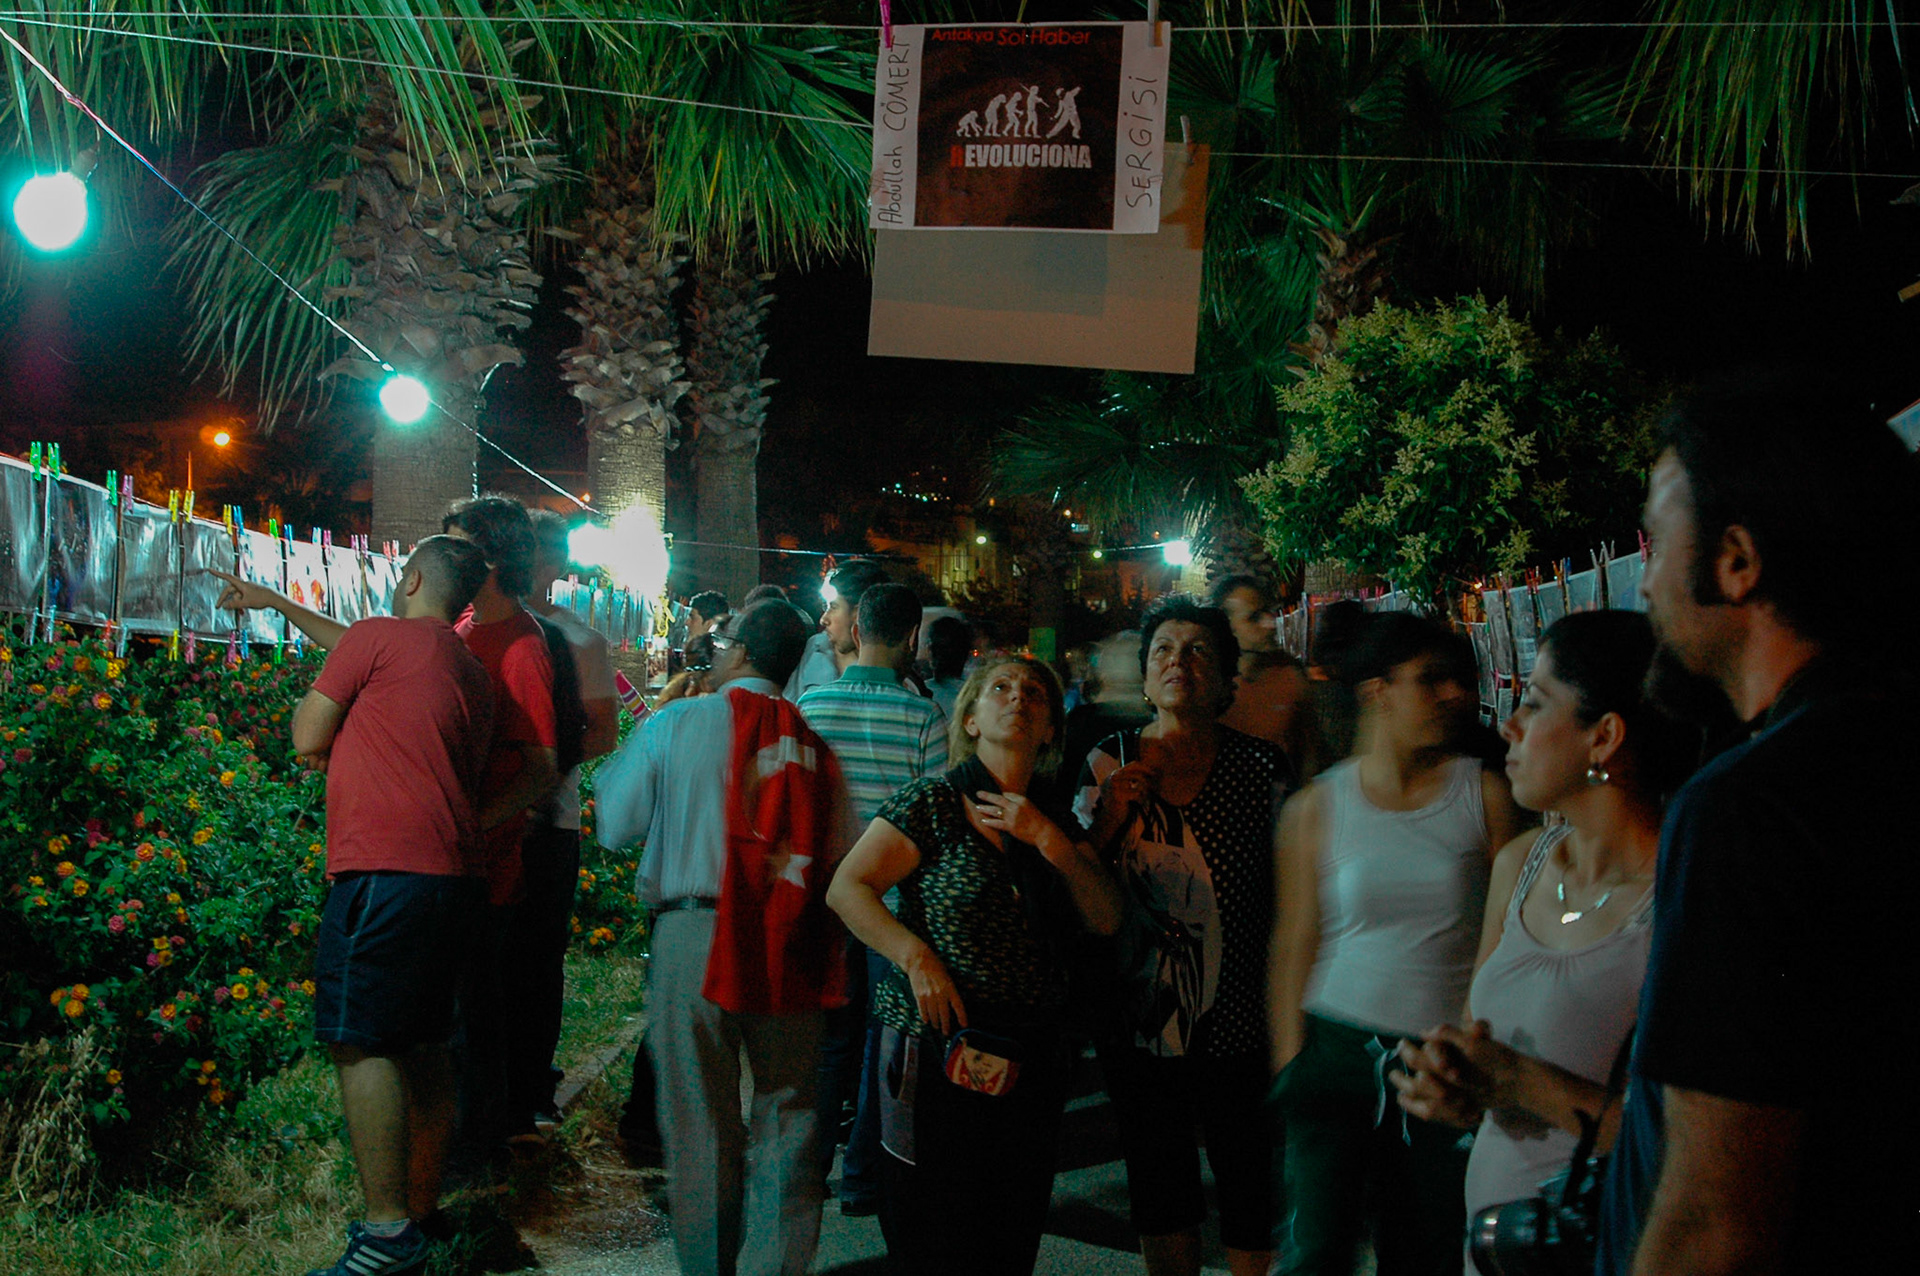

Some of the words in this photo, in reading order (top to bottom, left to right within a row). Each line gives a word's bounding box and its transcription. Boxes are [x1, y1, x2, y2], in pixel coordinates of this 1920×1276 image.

[931, 28, 995, 43] Antakya
[1031, 27, 1091, 45] Haber
[880, 35, 910, 131] CÖMERT
[950, 143, 1093, 169] REVOLUCIONA
[877, 146, 903, 226] Abdullah
